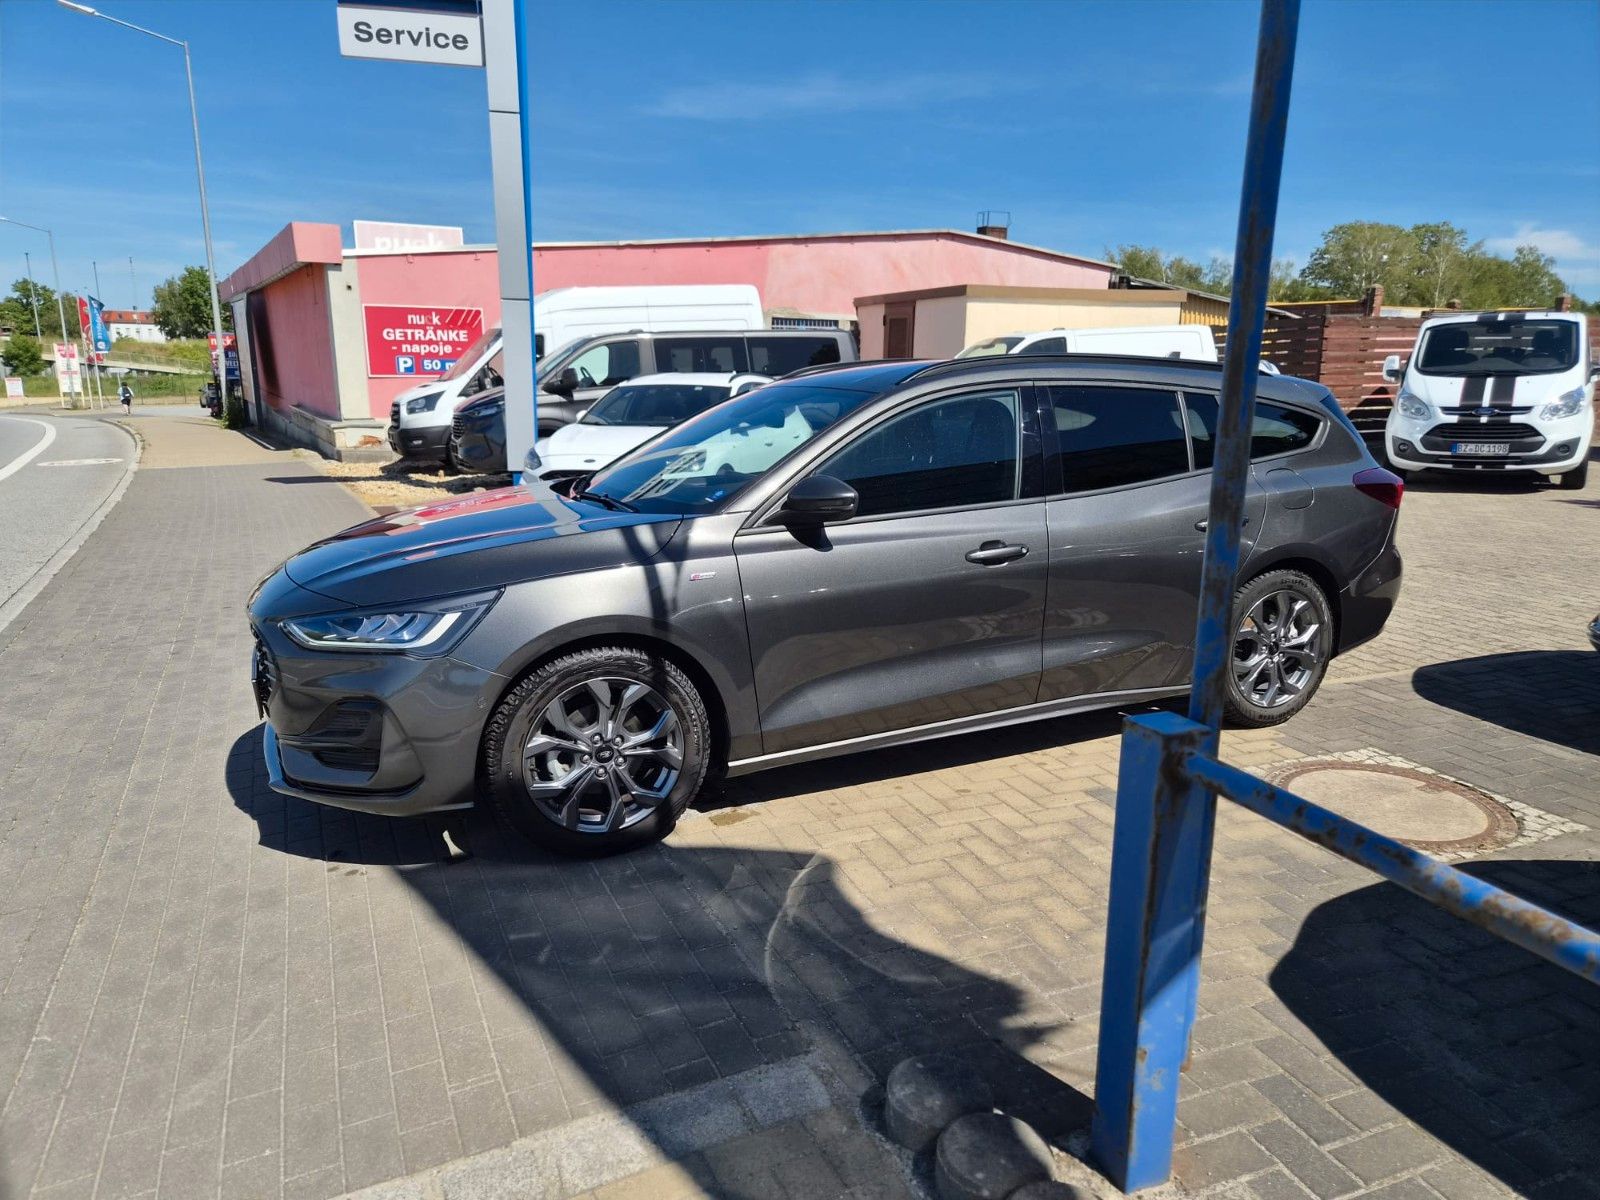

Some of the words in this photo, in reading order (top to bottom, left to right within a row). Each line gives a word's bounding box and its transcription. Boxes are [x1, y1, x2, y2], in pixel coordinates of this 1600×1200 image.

[353, 21, 469, 51] Service
[382, 326, 469, 342] GETRÄNKE
[401, 342, 453, 356] napoje
[398, 357, 413, 373] P
[423, 359, 442, 370] 50
